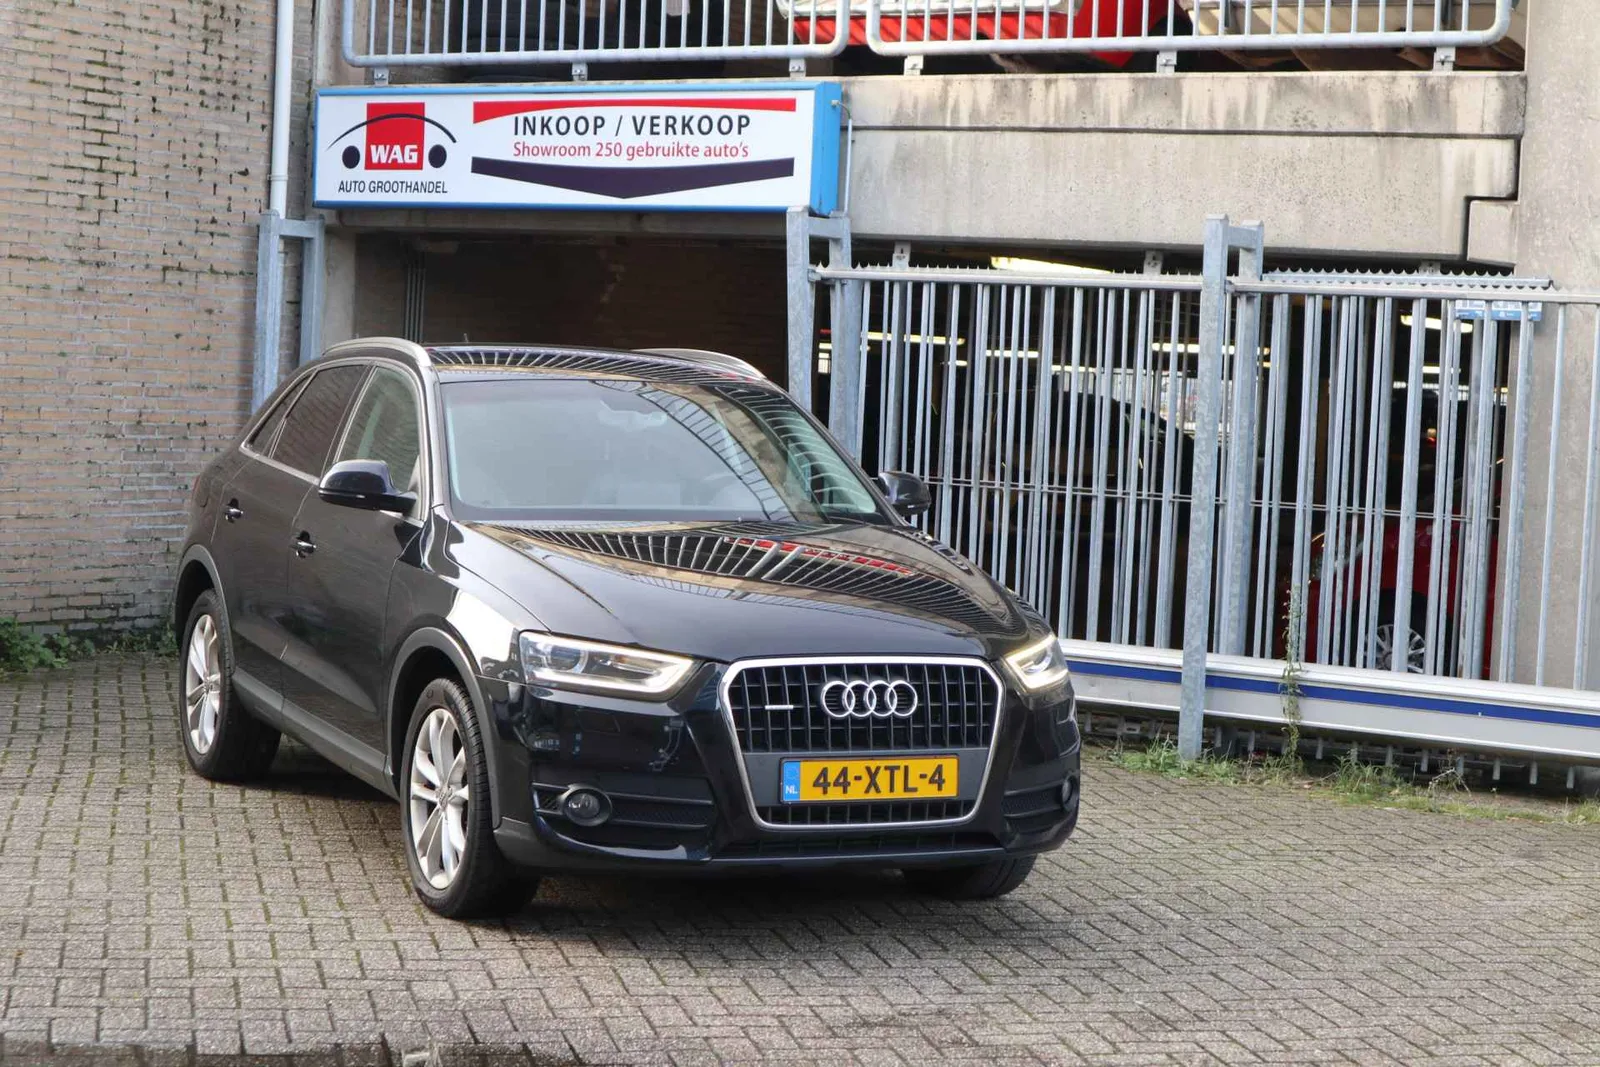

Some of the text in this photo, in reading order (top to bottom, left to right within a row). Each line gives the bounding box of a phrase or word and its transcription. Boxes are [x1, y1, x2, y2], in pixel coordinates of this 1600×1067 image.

[513, 115, 606, 137] INKOOP
[632, 114, 751, 137] VERKOOP
[370, 144, 419, 165] WAG
[513, 141, 749, 162] Showroom 250 gebruikte auto's
[338, 180, 448, 194] AUTO GROOTHANDEL
[785, 784, 799, 795] NL
[812, 763, 946, 796] 44-XTL-4
